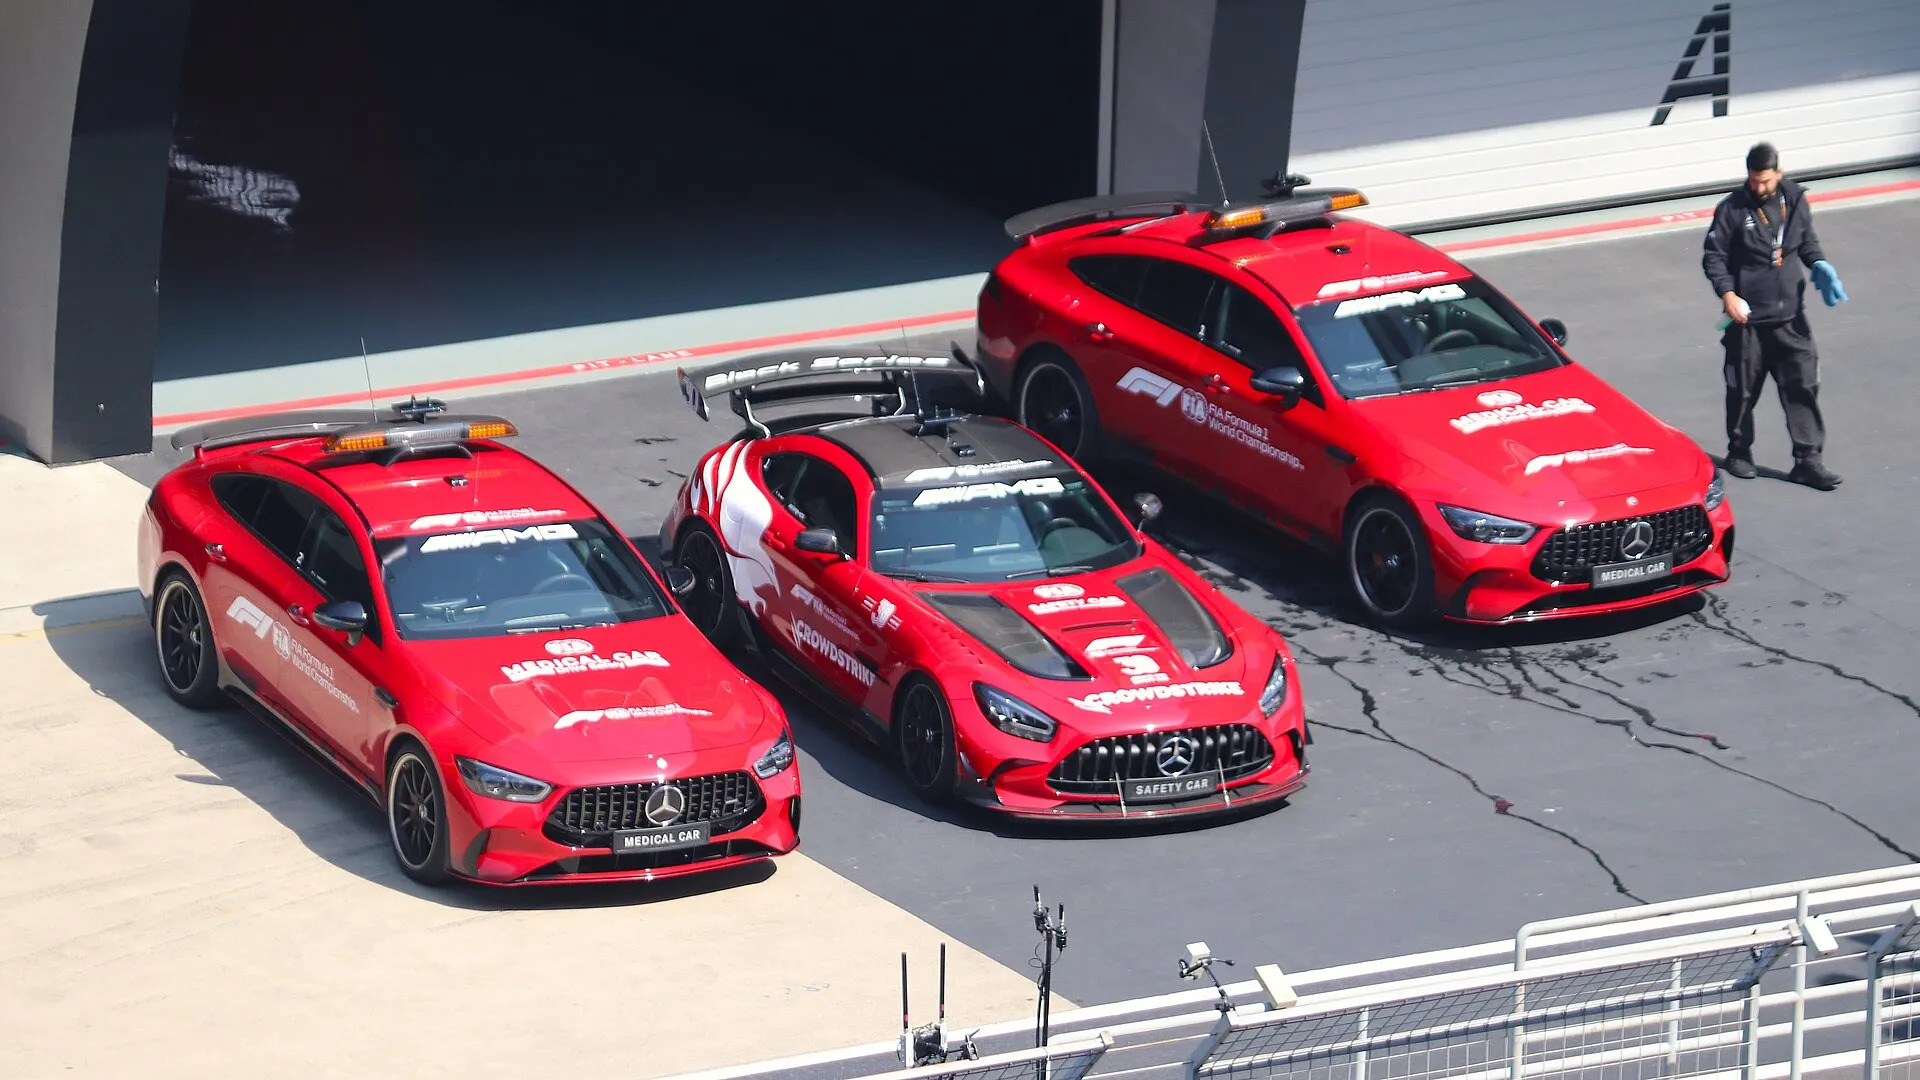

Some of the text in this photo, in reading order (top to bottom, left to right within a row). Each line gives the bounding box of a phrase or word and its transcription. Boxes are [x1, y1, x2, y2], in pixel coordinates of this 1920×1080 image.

[1649, 2, 1731, 126] A
[1378, 283, 1467, 311] AMG
[572, 359, 610, 371] PIT
[631, 349, 694, 364] LANE
[704, 354, 951, 391] Black Series
[1116, 366, 1184, 408] F1
[1208, 402, 1223, 420] FIA
[1223, 410, 1263, 438] Formula
[1208, 415, 1301, 471] World Championship
[962, 477, 1065, 503] AMG
[470, 523, 579, 547] AMG
[1601, 562, 1666, 581] MEDICAL CAR
[226, 595, 274, 639] F1
[291, 653, 311, 678] World
[302, 648, 330, 676] Formula
[501, 650, 672, 682] MEDICAL CAR
[1083, 681, 1245, 708] CROWDSTRIKE
[1135, 778, 1209, 796] SAFETY CAR
[624, 829, 701, 848] MEDICAL CAR
